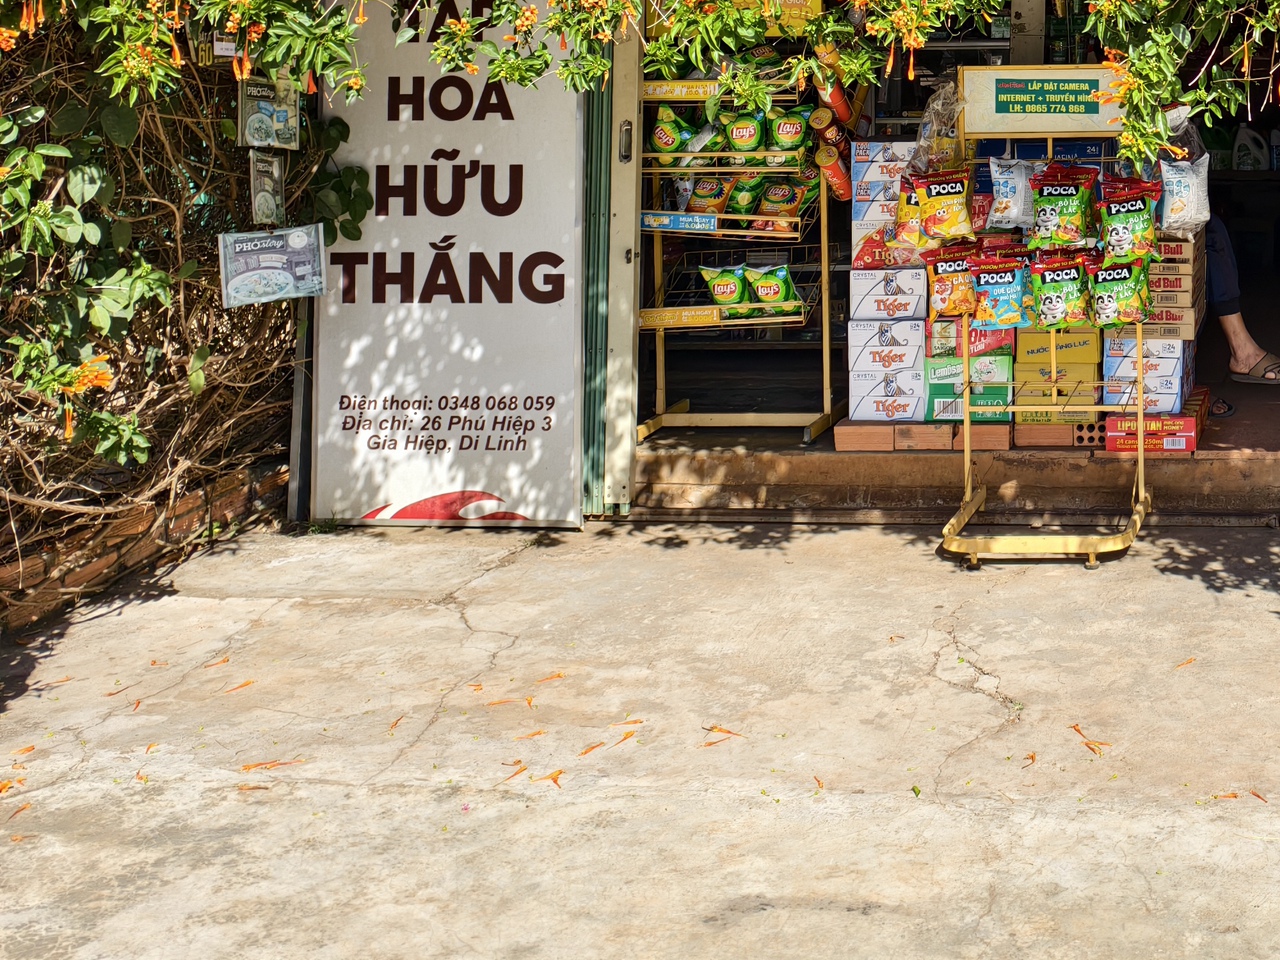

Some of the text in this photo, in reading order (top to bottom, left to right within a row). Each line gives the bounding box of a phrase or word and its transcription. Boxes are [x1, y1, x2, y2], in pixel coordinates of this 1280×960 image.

[198, 42, 213, 67] 60
[1059, 83, 1089, 91] CAMERA
[998, 94, 1036, 102] INTERNET
[1009, 104, 1085, 113] LH: 0865 774 868
[374, 148, 524, 217] HỮU
[929, 182, 963, 196] POCA
[1043, 186, 1077, 196] POCA
[879, 203, 898, 217] Tig
[1110, 200, 1145, 214] POCA
[1163, 243, 1183, 255] Bull
[872, 248, 894, 266] Tig
[330, 234, 566, 304] THẮNG
[936, 260, 969, 273] POCA
[979, 272, 1013, 285] POCA
[1044, 269, 1078, 282] POCA
[1097, 269, 1129, 282] POCA
[1149, 277, 1182, 289] ed Bull
[874, 297, 911, 317] Tiger
[869, 349, 907, 369] Tiger
[1131, 359, 1160, 375] Tger
[339, 394, 556, 416] Điện thoại: 0348 068 059
[872, 399, 910, 418] Tiger
[1131, 395, 1160, 411] Tger
[342, 414, 553, 435] Địa chỉ: 26 Phú Hiệp 3
[1117, 420, 1162, 431] LIPOITAN
[367, 434, 527, 455] Gia Hiệp, Di Linh
